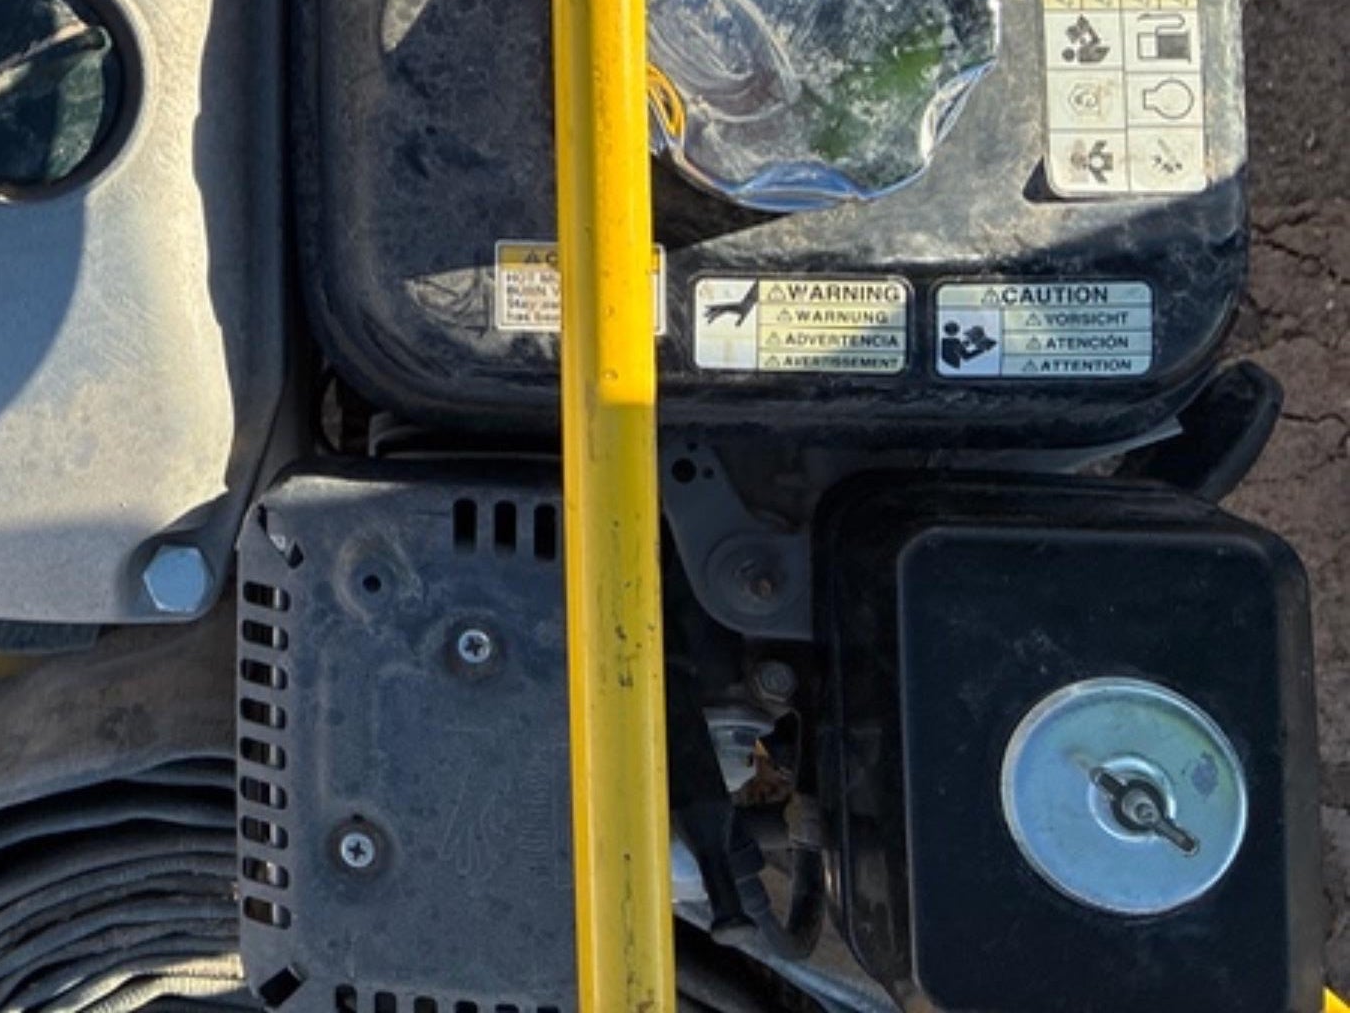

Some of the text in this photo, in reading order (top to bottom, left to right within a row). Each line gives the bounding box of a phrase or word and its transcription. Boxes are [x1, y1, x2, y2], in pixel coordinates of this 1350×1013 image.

[786, 283, 901, 302] WARNING
[1001, 286, 1109, 305] CAUTION
[795, 310, 889, 324] WARNUNG
[1044, 312, 1129, 327] VORSICHT
[784, 332, 899, 348] ADVERTENCIA
[782, 355, 899, 368] AVERTISSEMENT
[1040, 359, 1132, 373] ATTENTION
